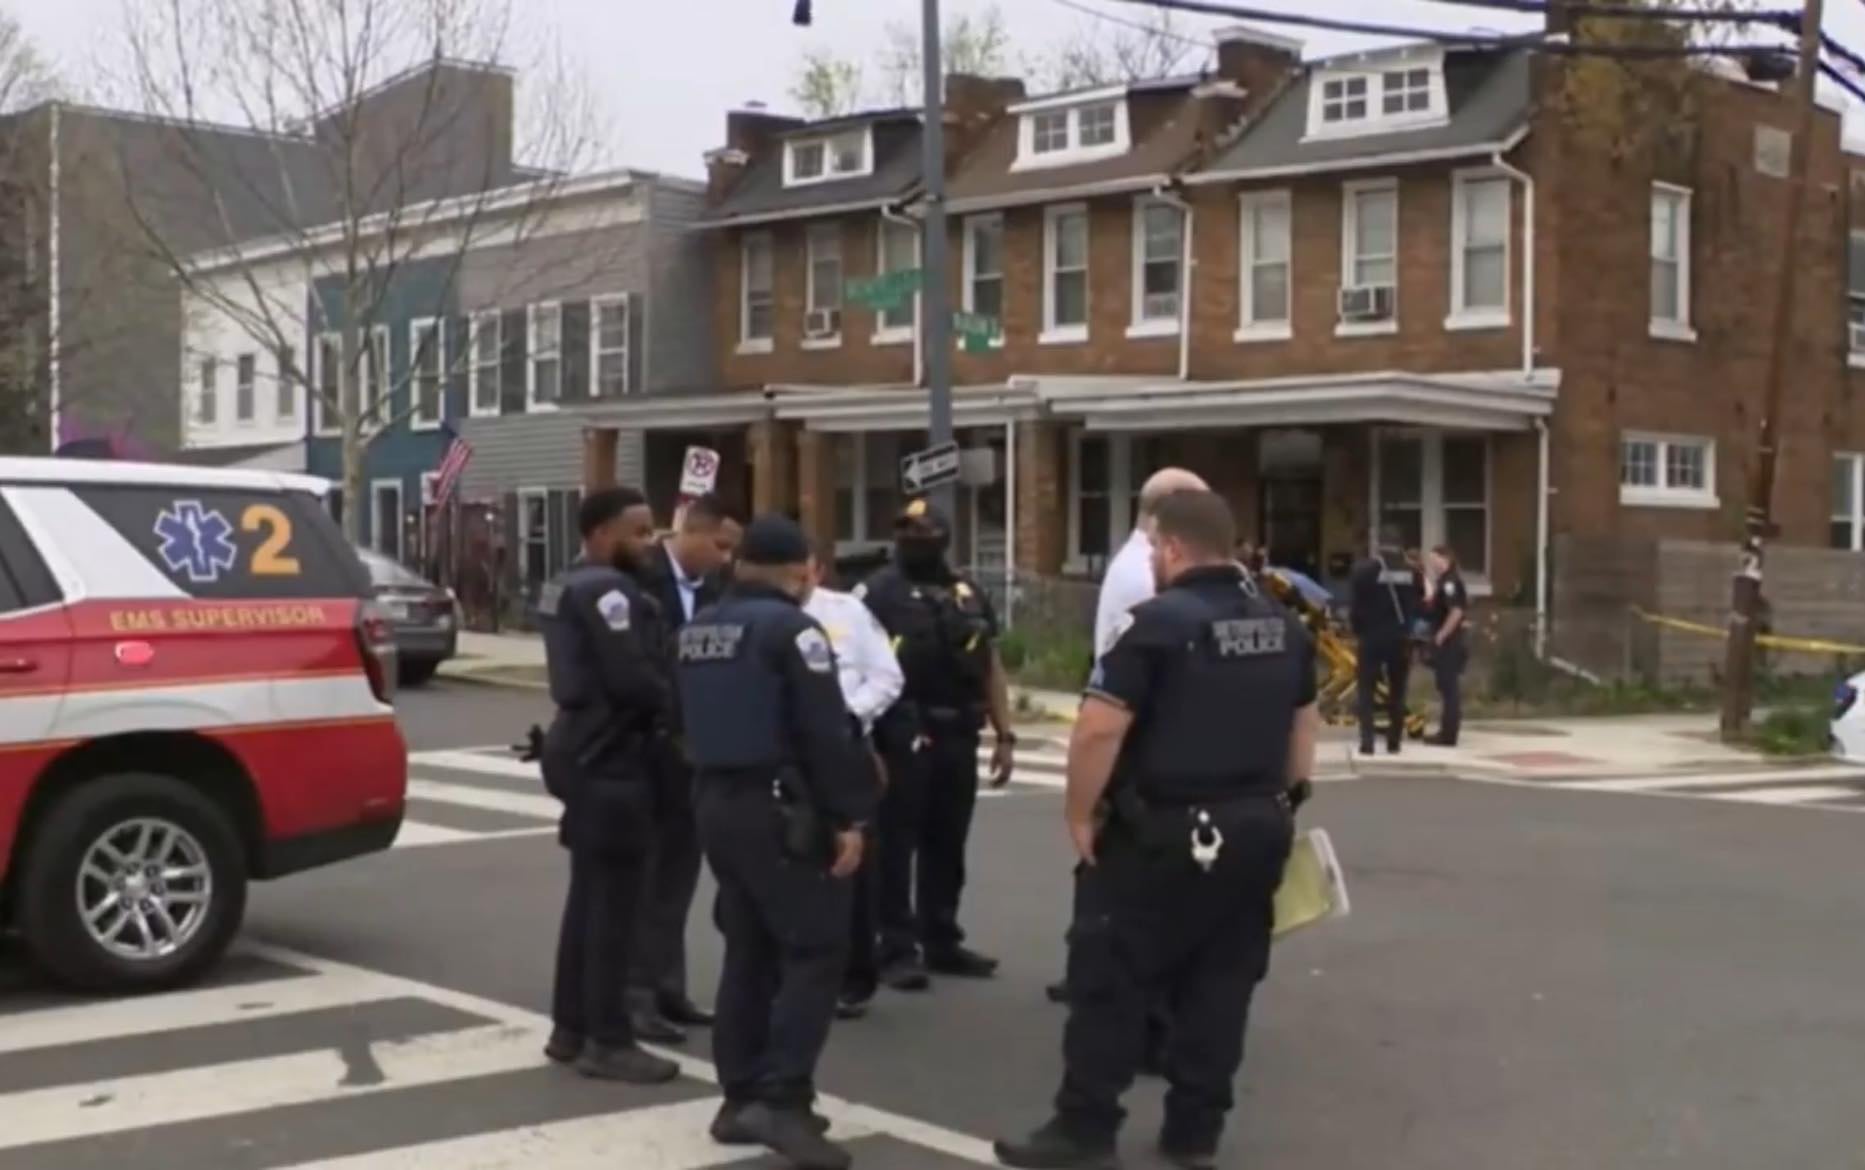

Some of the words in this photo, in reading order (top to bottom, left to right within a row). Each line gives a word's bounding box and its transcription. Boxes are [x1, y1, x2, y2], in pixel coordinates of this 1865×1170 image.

[241, 504, 299, 574] 2
[109, 609, 166, 632] EMS
[171, 605, 325, 629] SUPERVISOR
[678, 640, 735, 661] POLICE
[1219, 635, 1286, 656] POLICE
